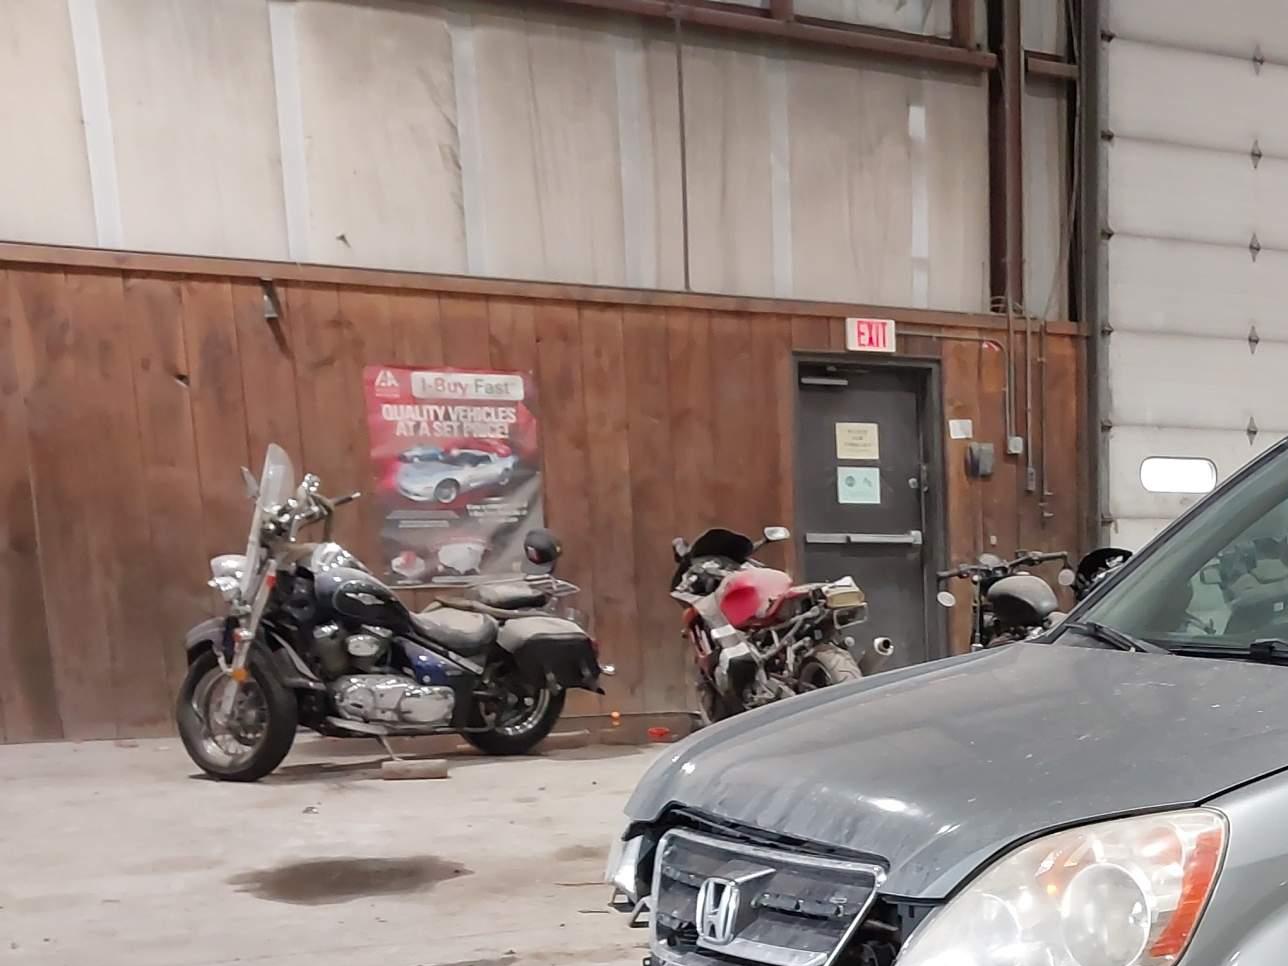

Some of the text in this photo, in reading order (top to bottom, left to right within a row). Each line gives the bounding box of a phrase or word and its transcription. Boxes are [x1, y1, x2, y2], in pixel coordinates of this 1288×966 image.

[857, 320, 887, 347] EXIT
[381, 404, 516, 423] QUALITY VEHICLES
[396, 422, 416, 437] AT
[417, 422, 431, 437] A
[432, 422, 460, 438] SET
